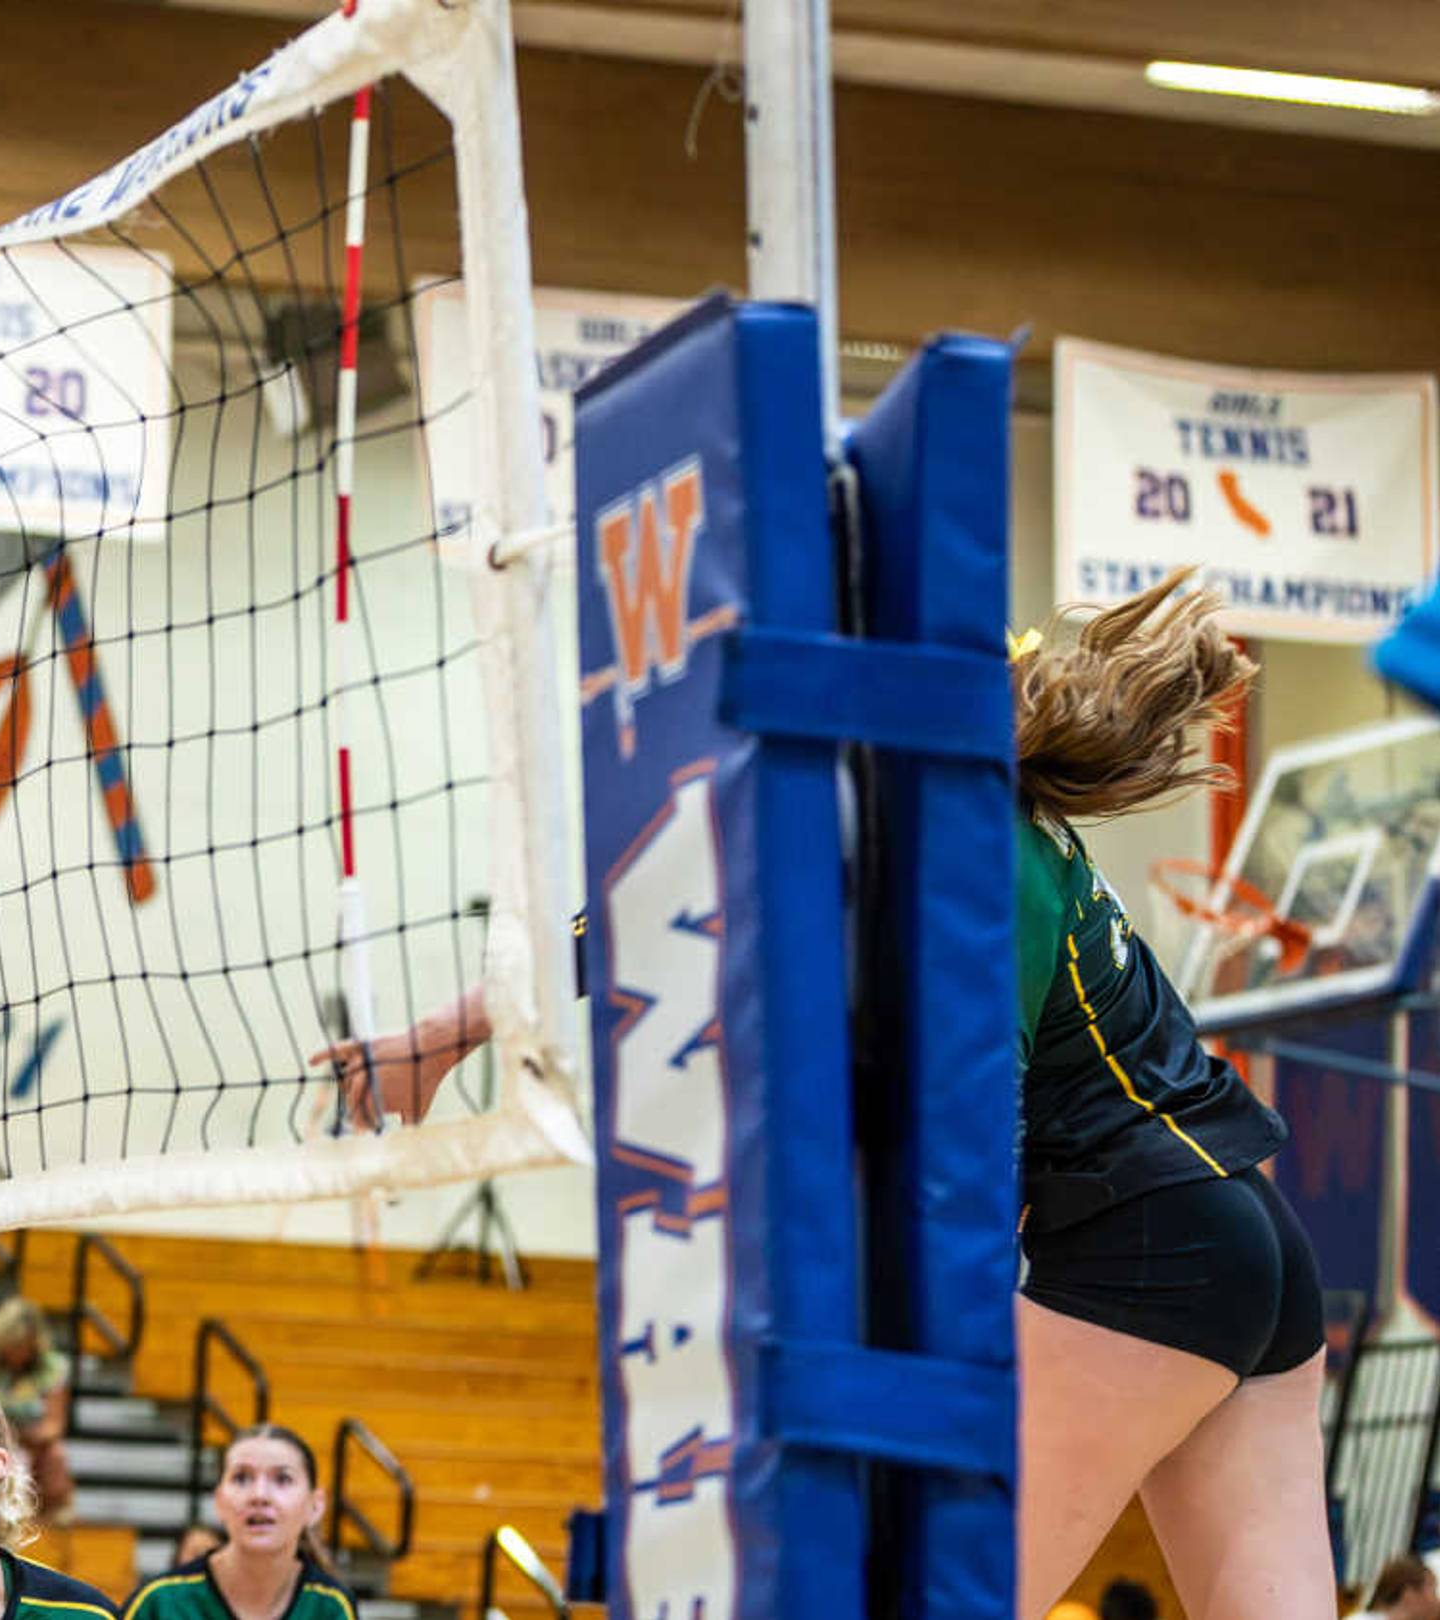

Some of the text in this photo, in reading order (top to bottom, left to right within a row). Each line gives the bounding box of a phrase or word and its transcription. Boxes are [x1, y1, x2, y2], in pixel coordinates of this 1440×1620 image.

[25, 365, 88, 420] 20
[1174, 419, 1312, 466] TENNIS
[1135, 466, 1358, 539] 20 21
[594, 453, 703, 699] W
